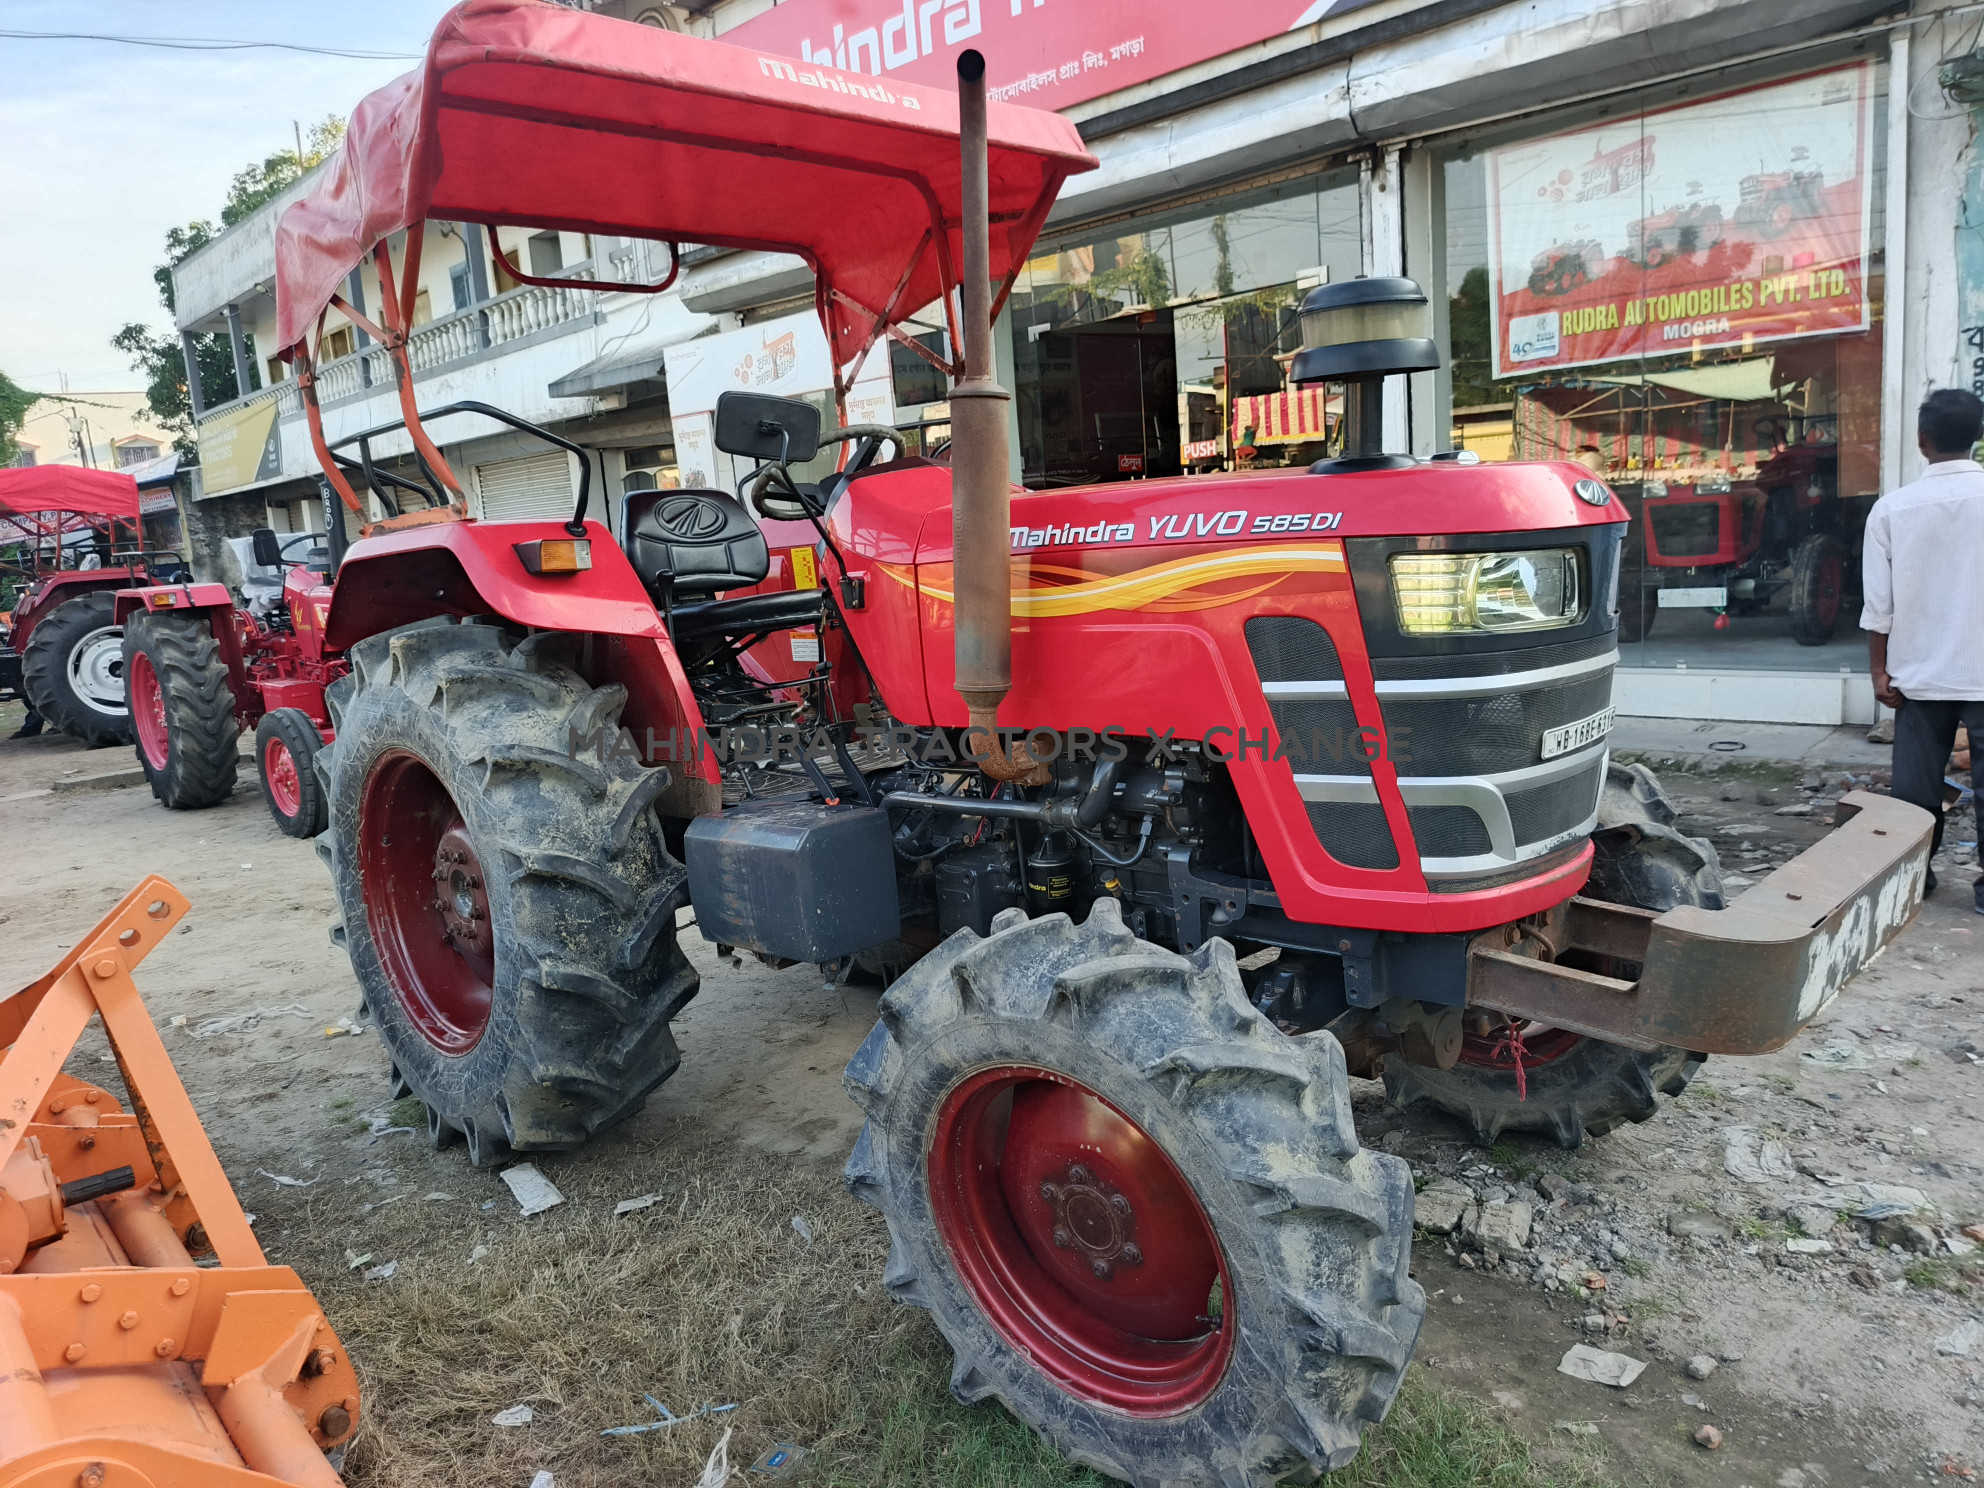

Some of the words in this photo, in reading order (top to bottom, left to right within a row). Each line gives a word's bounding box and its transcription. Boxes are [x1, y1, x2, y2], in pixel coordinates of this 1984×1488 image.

[801, 0, 982, 76] hindra
[986, 68, 1059, 101] টোমোবাইলস্
[1562, 306, 1619, 337] RUDRA
[1623, 282, 1754, 327] AUTOMOBILES
[1760, 274, 1802, 307] PVT.
[1808, 268, 1851, 300] LTD.
[1663, 317, 1730, 341] MOGRA
[1184, 440, 1217, 459] PUSH
[141, 493, 171, 504] ACHINERY
[1010, 520, 1135, 547] Mahindra
[1149, 510, 1249, 540] YUVO
